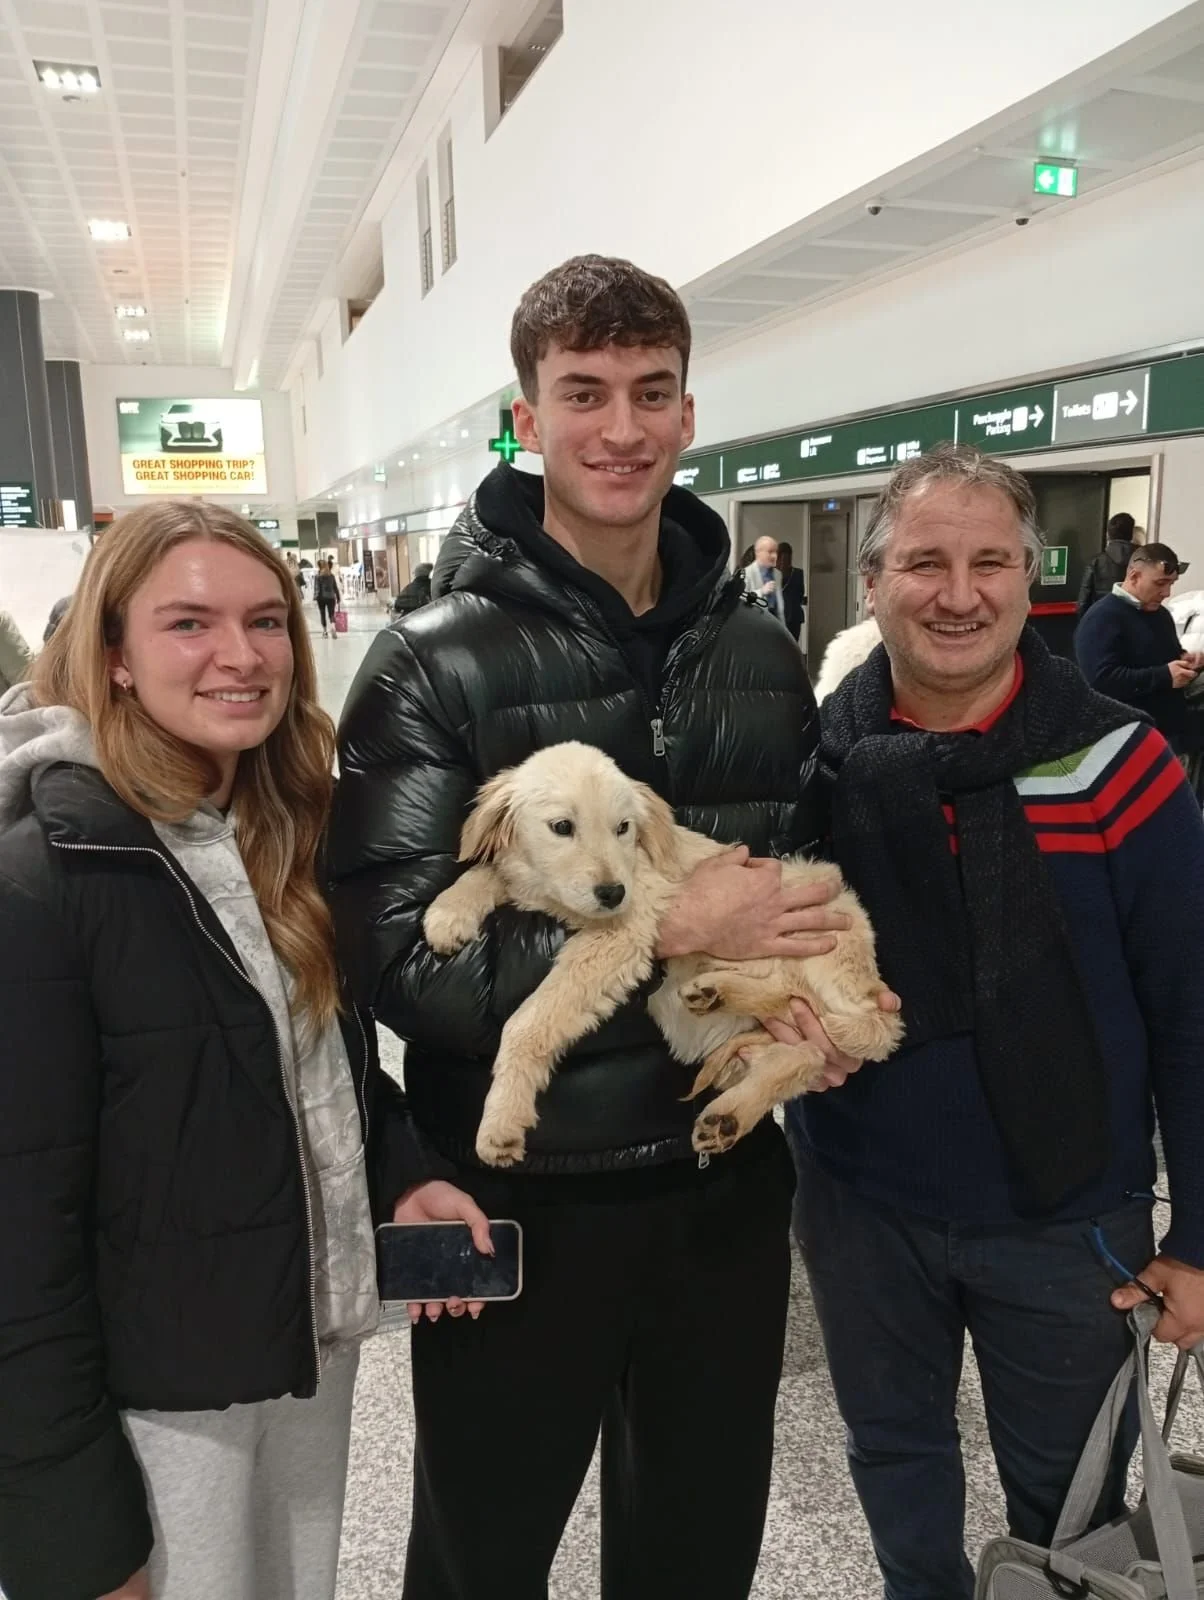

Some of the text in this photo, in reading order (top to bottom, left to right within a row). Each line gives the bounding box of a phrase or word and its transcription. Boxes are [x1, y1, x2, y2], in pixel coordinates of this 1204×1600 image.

[132, 459, 255, 470] GREAT SHOPPING TRIP?
[135, 471, 255, 481] GREAT SHOPPING CAR!
